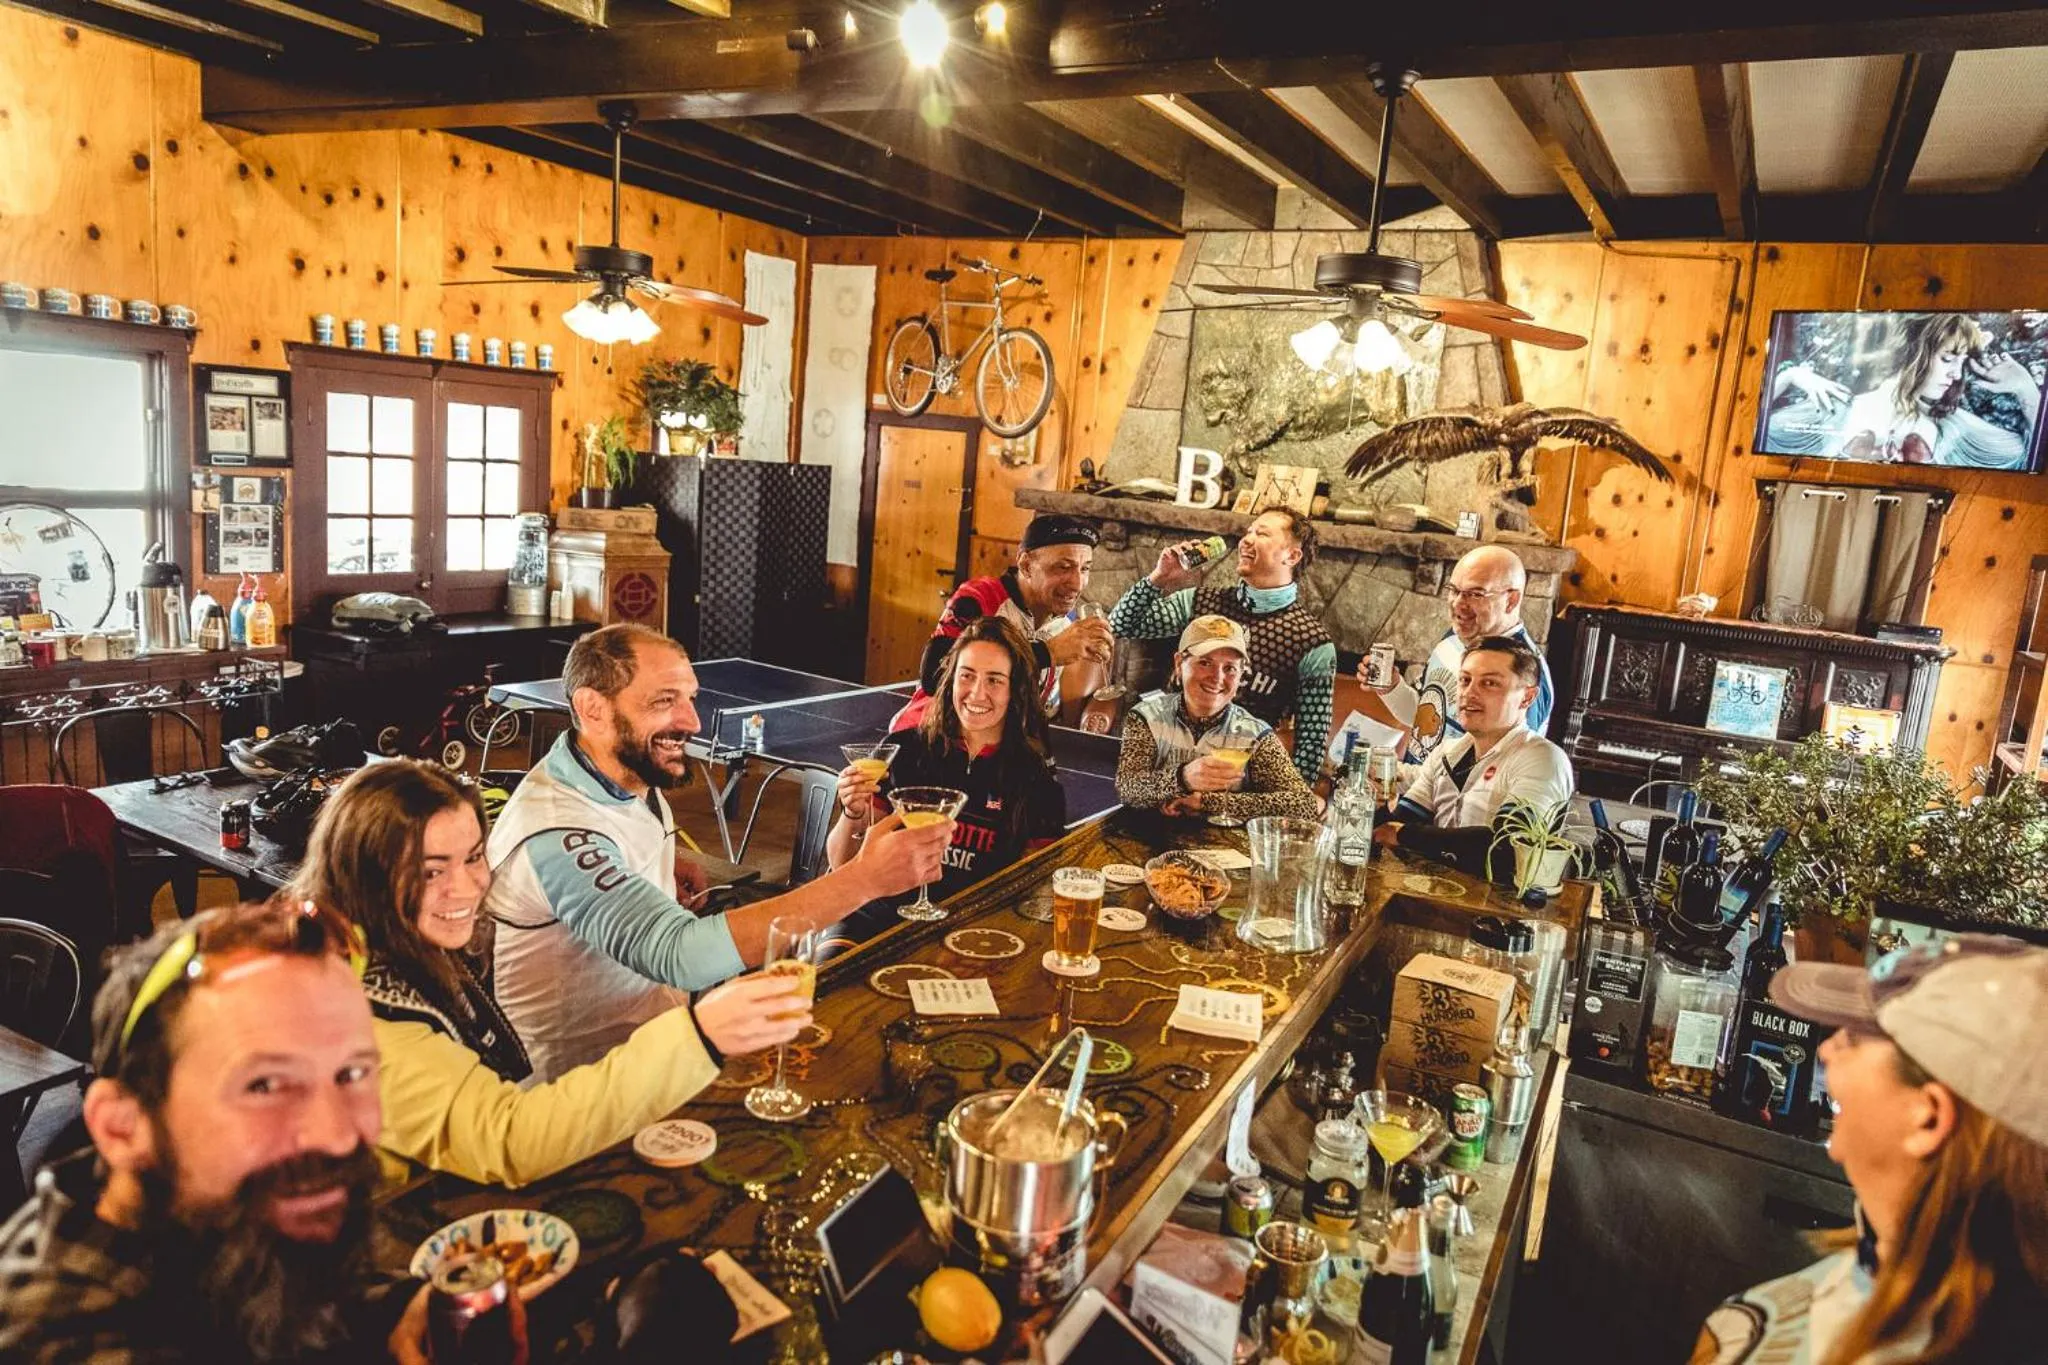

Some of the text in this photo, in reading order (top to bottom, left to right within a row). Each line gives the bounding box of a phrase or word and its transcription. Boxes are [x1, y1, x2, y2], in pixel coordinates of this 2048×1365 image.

[1172, 445, 1224, 509] B
[1420, 1007, 1475, 1024] HUNDRED
[1751, 1010, 1811, 1038] BLACK BOX
